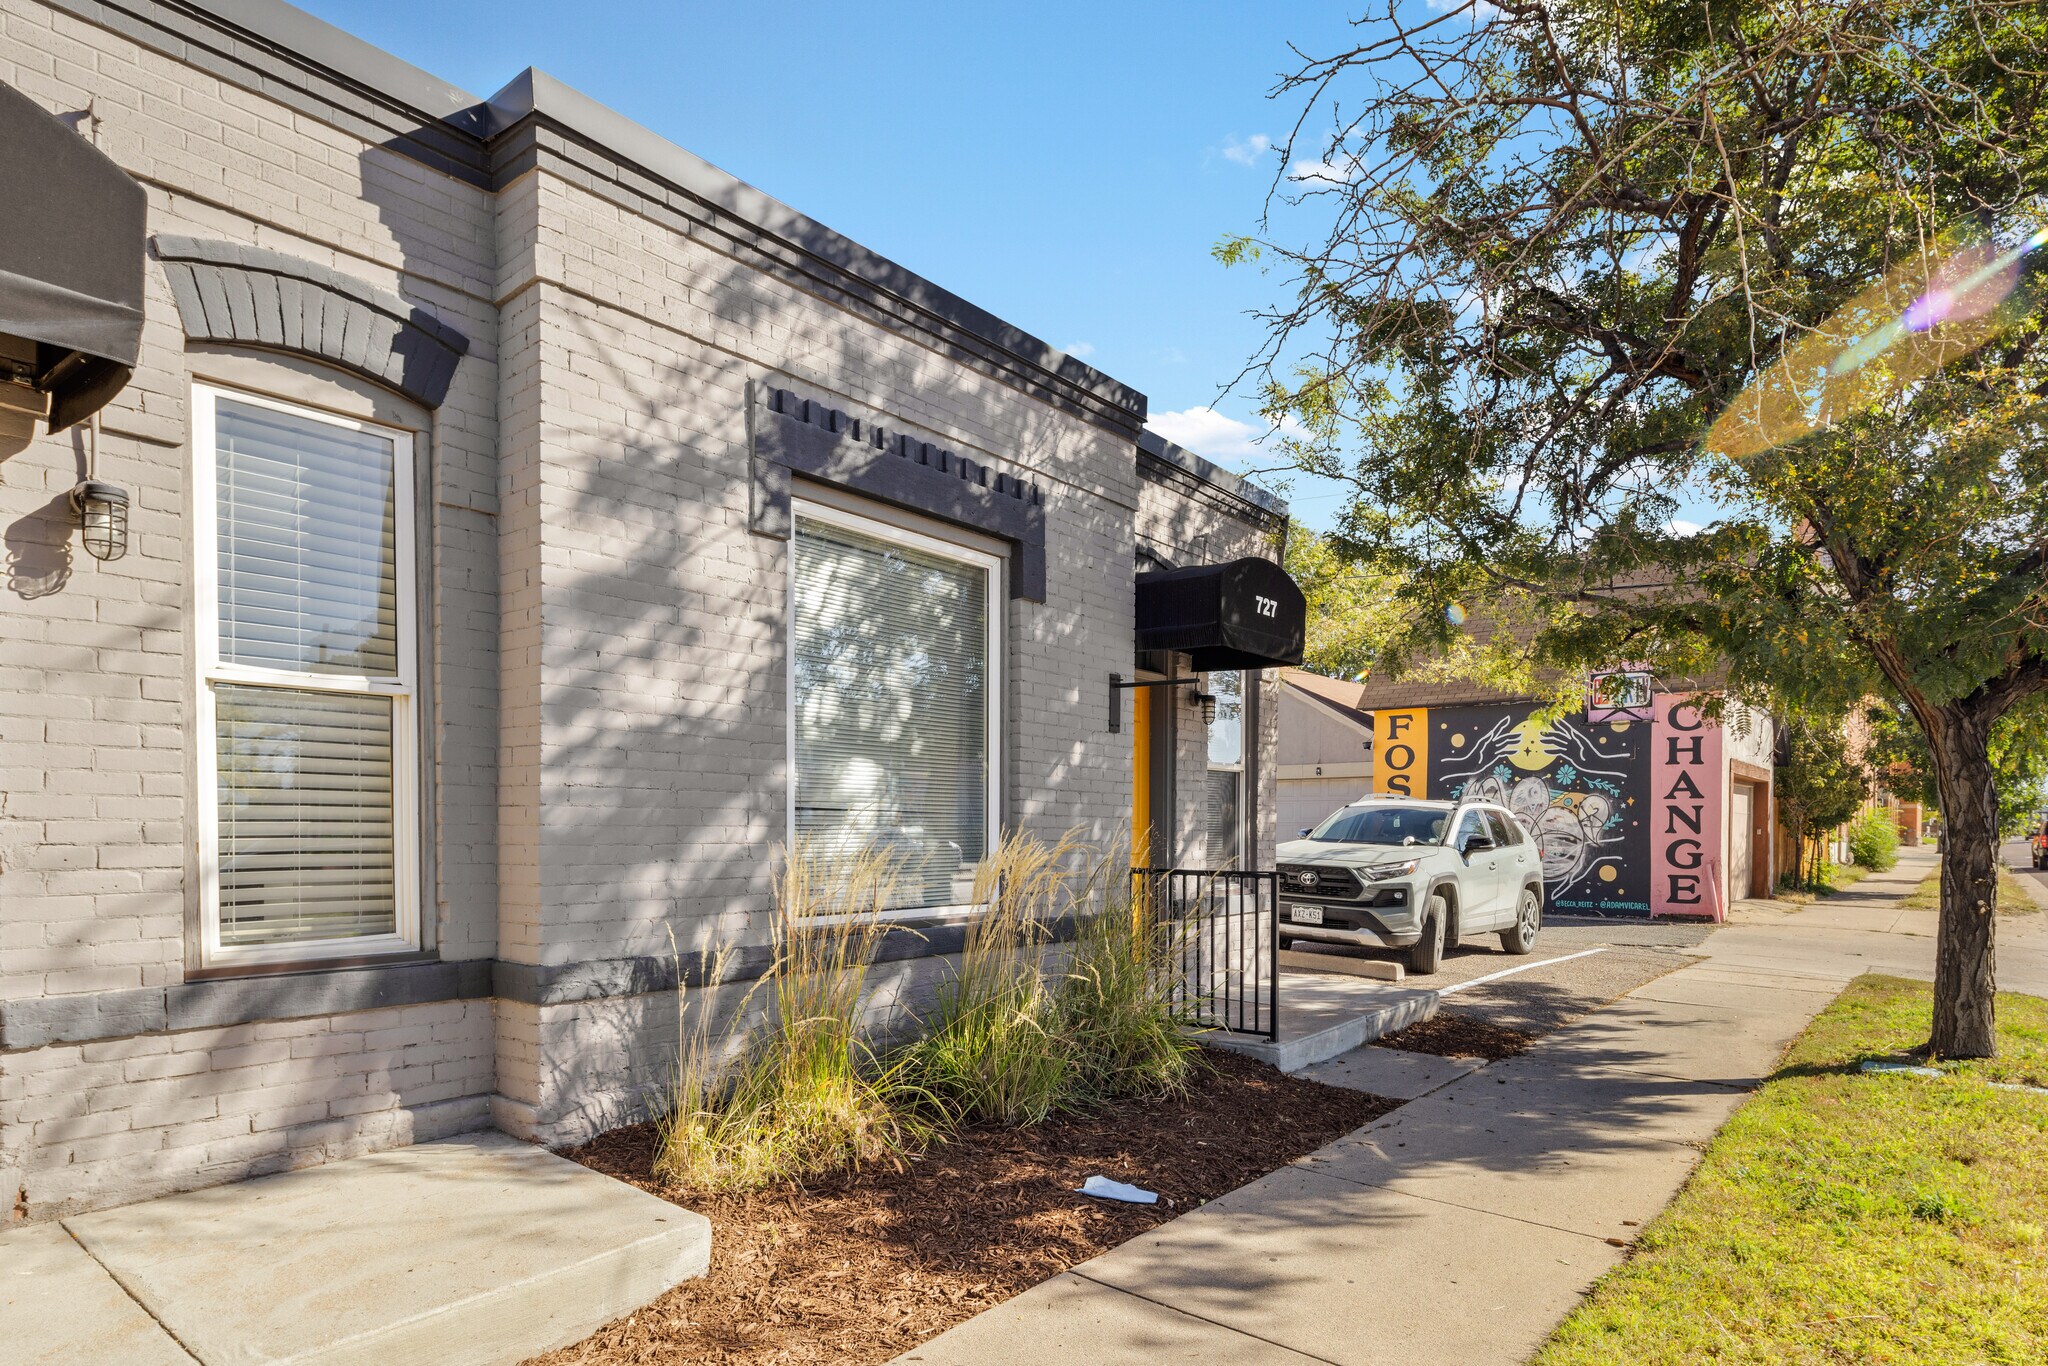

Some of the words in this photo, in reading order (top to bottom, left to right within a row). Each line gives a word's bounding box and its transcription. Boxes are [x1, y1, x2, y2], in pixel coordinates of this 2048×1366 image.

[1255, 595, 1278, 618] 727
[1663, 702, 1705, 904] CHANGE
[1600, 901, 1650, 910] @ADAMVICAREL
